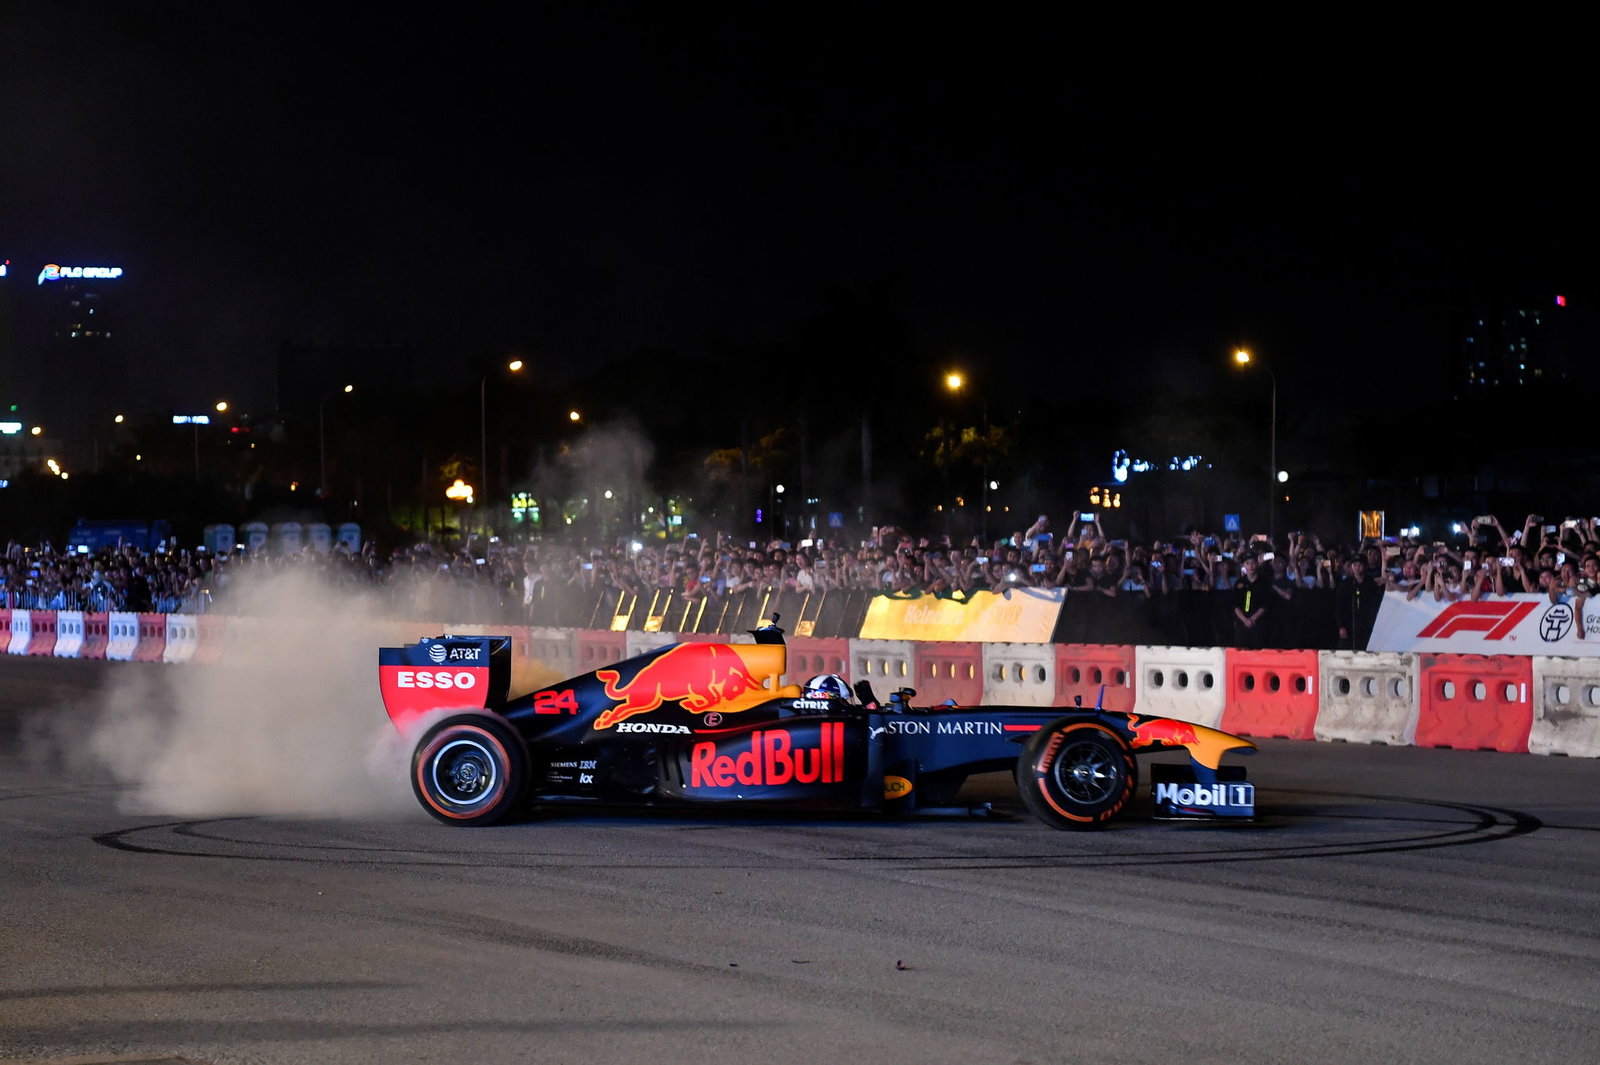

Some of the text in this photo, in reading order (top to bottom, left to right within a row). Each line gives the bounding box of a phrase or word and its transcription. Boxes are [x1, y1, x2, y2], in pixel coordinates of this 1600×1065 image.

[1416, 601, 1541, 640] F1
[450, 648, 481, 660] AT&T
[397, 671, 476, 689] ESSO
[533, 689, 579, 715] 24
[616, 722, 692, 735] HONDA
[937, 722, 1003, 735] MARTIN
[579, 760, 597, 769] IBM
[1156, 782, 1227, 806] Mobil
